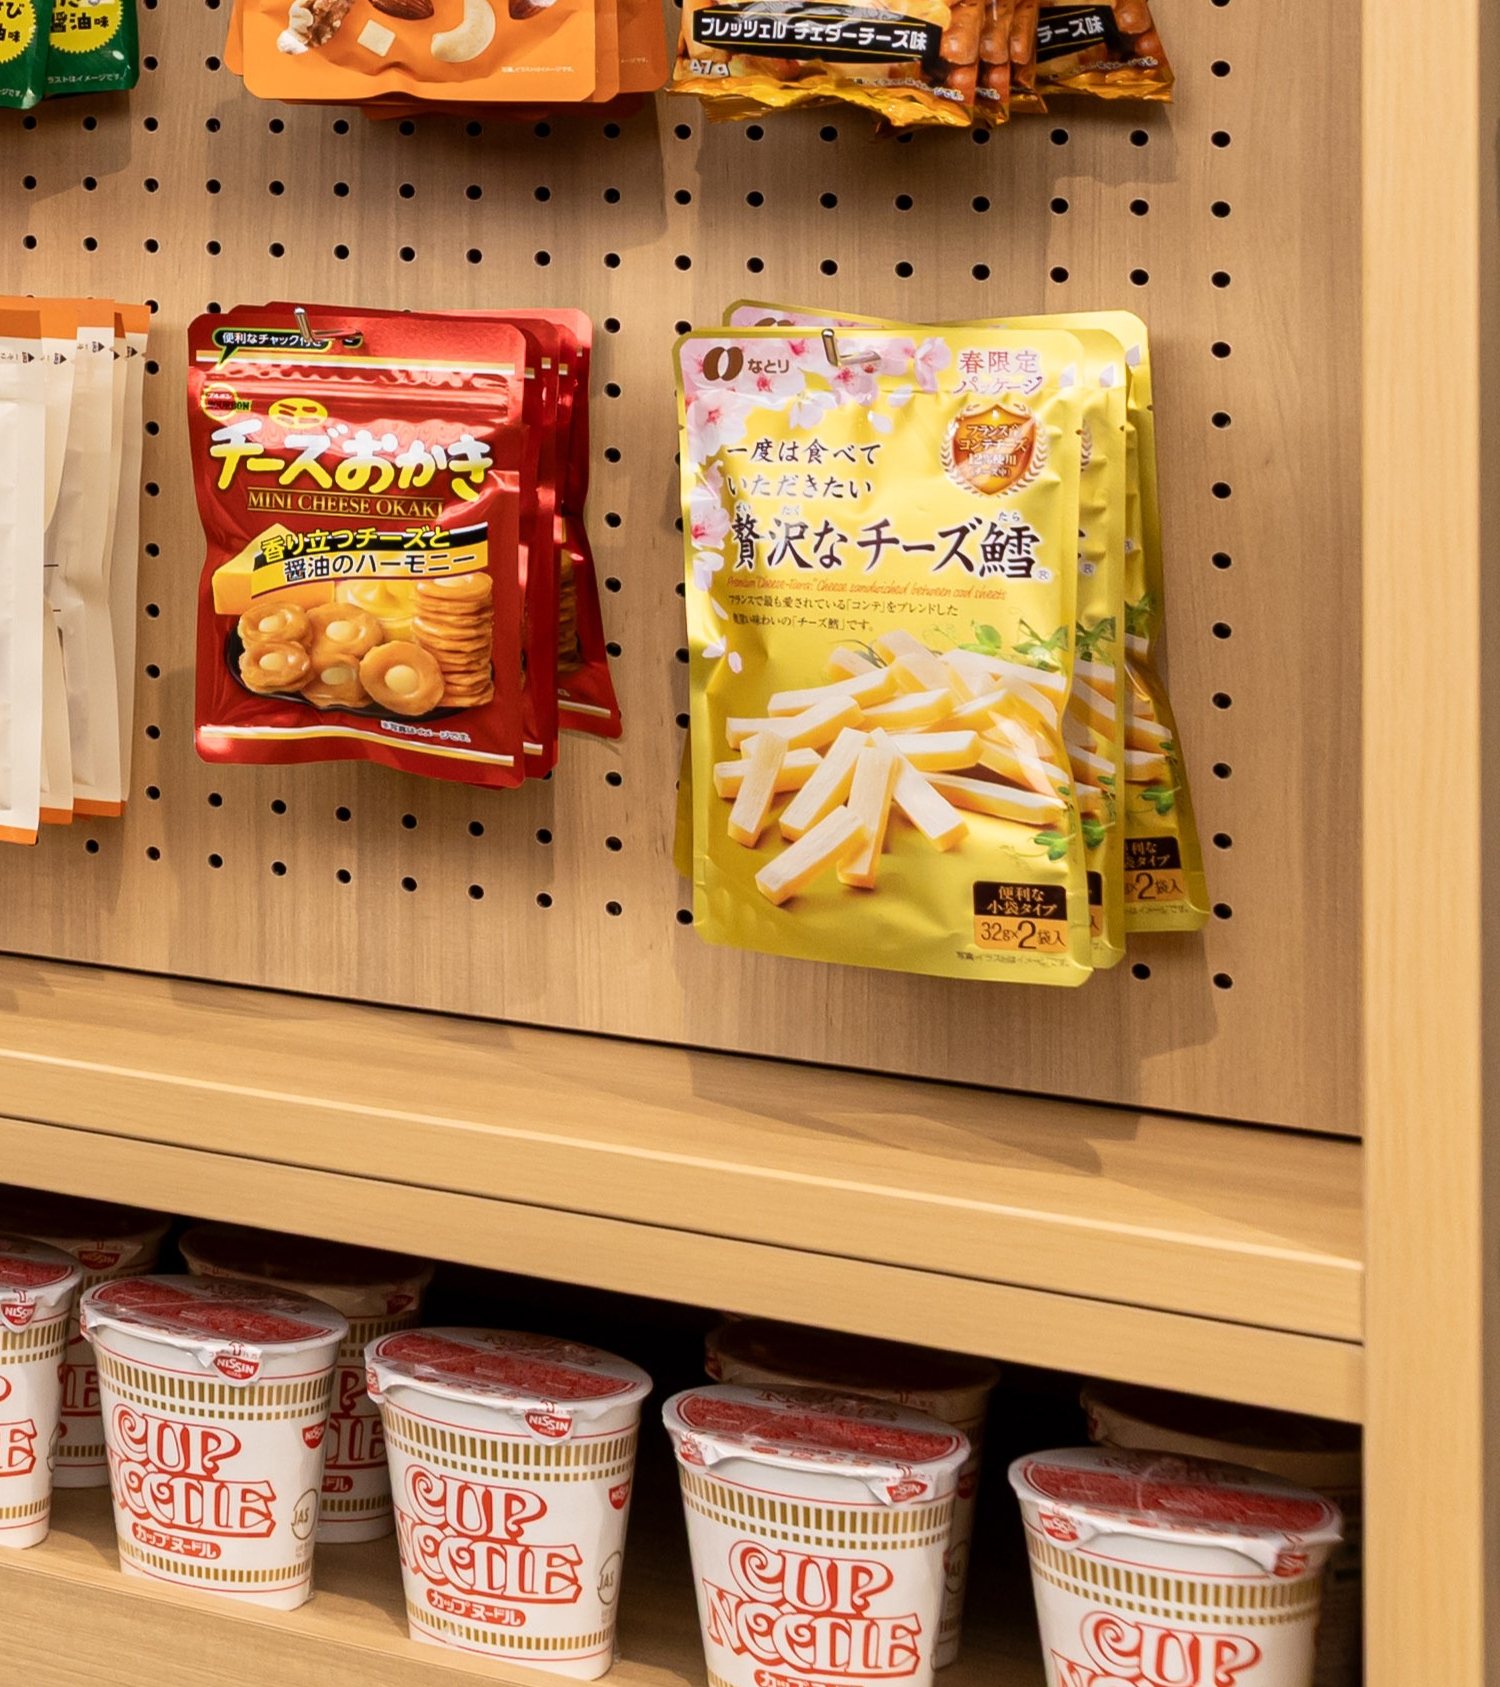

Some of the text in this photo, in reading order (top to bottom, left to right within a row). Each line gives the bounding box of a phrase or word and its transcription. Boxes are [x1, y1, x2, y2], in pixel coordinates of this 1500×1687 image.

[700, 17, 928, 52] プレッツェル チェダーチーズ味
[1037, 14, 1105, 44] チーズ味
[748, 357, 790, 375] なとり
[959, 350, 1039, 375] 春限定
[953, 374, 1043, 396] パッケージ
[209, 420, 494, 502] チーズおかき
[726, 440, 881, 466] 一度は食べて
[728, 473, 873, 500] いただきたい
[248, 489, 444, 521] MINI CHEESE OKAKI
[261, 525, 453, 563] 香り立つチーズと
[730, 514, 1042, 580] 贅沢なチーズ鱈
[284, 551, 477, 582] 醤油のハーモニー
[987, 900, 1058, 917] 小袋タイプ
[999, 886, 1046, 901] 便利な
[4, 1306, 35, 1319] NISSIN
[216, 1358, 256, 1376] NISSIN
[528, 1414, 569, 1432] NISSIN
[112, 1403, 242, 1480] CUP
[107, 1449, 277, 1538] NOODLE
[404, 1464, 548, 1544] CUP
[135, 1523, 217, 1558] カップヌードル
[393, 1504, 583, 1604] NOODLE
[729, 1540, 894, 1618] CUP
[430, 1590, 521, 1626] カップヌードル
[702, 1577, 923, 1678] NOODLE
[1080, 1610, 1263, 1687] CUP
